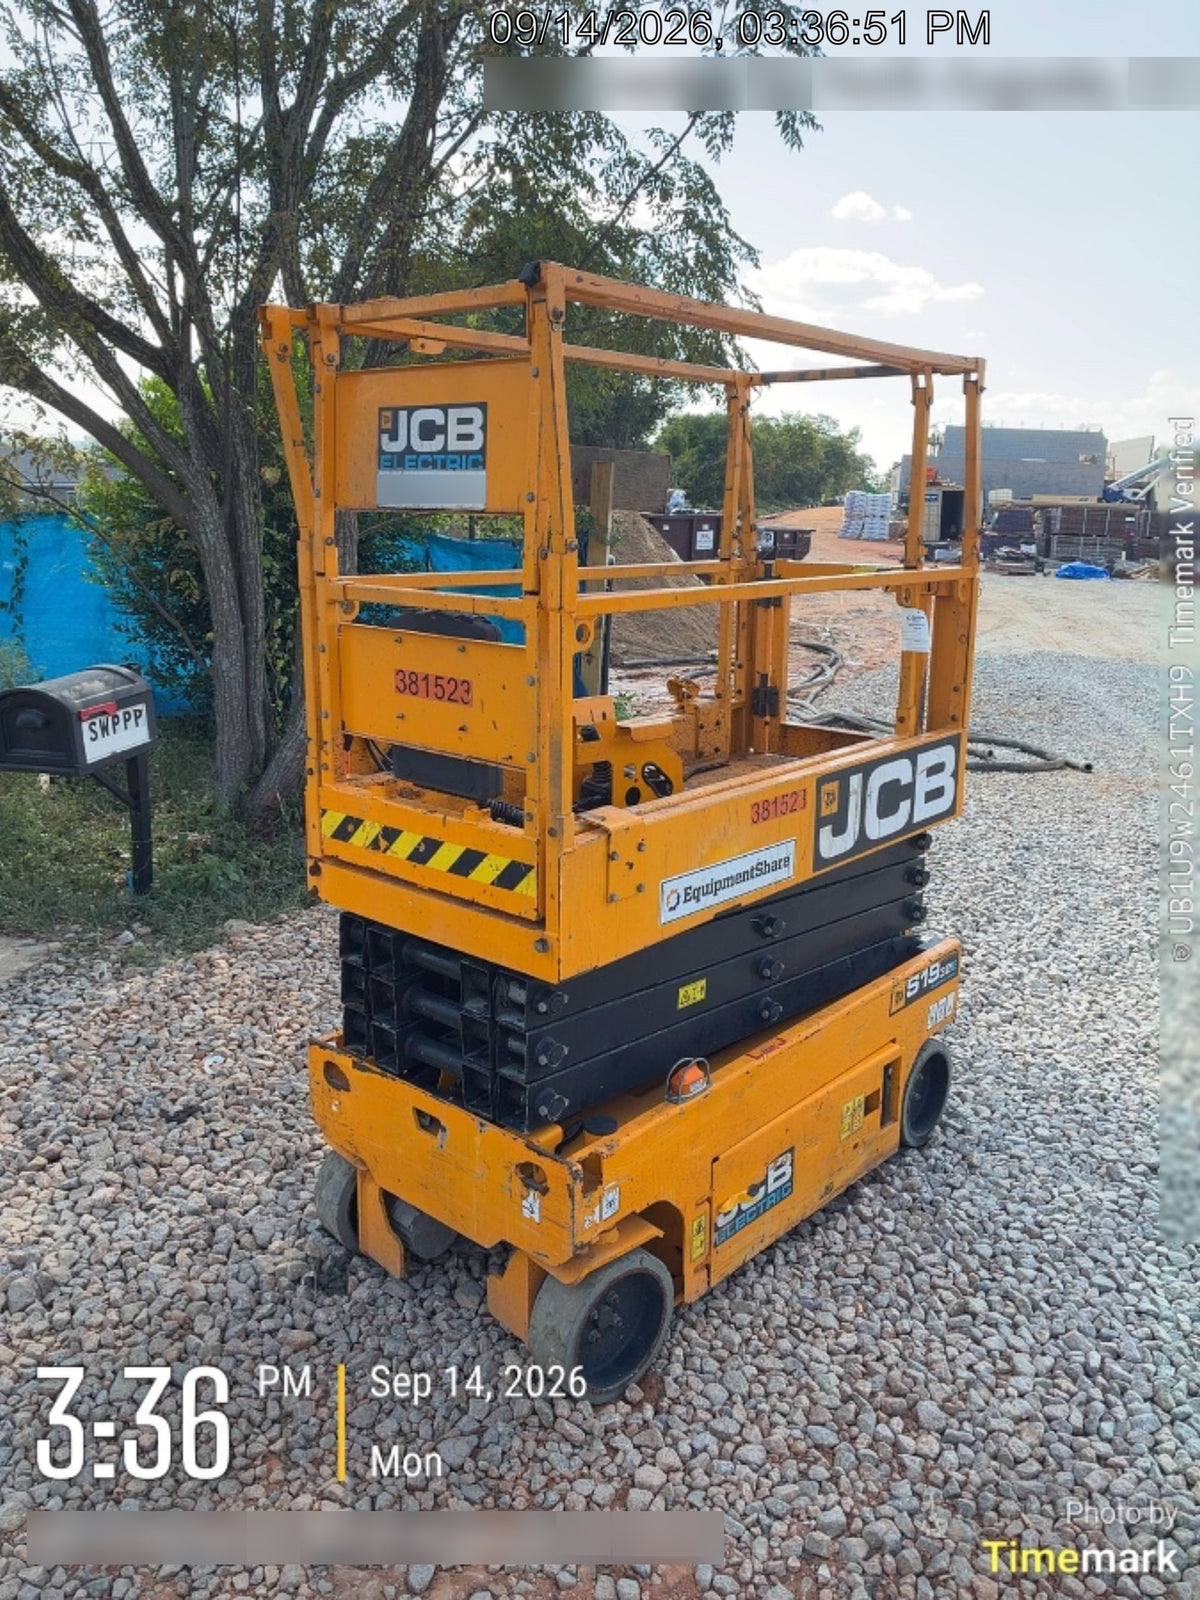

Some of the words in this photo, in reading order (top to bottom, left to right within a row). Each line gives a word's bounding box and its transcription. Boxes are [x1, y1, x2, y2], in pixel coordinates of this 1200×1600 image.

[380, 407, 485, 452] JCB
[380, 454, 484, 471] ELECTRIC
[395, 669, 471, 705] 381523
[88, 709, 143, 742] SWPPP
[819, 744, 956, 859] JCB
[682, 856, 791, 904] EquipmentShare
